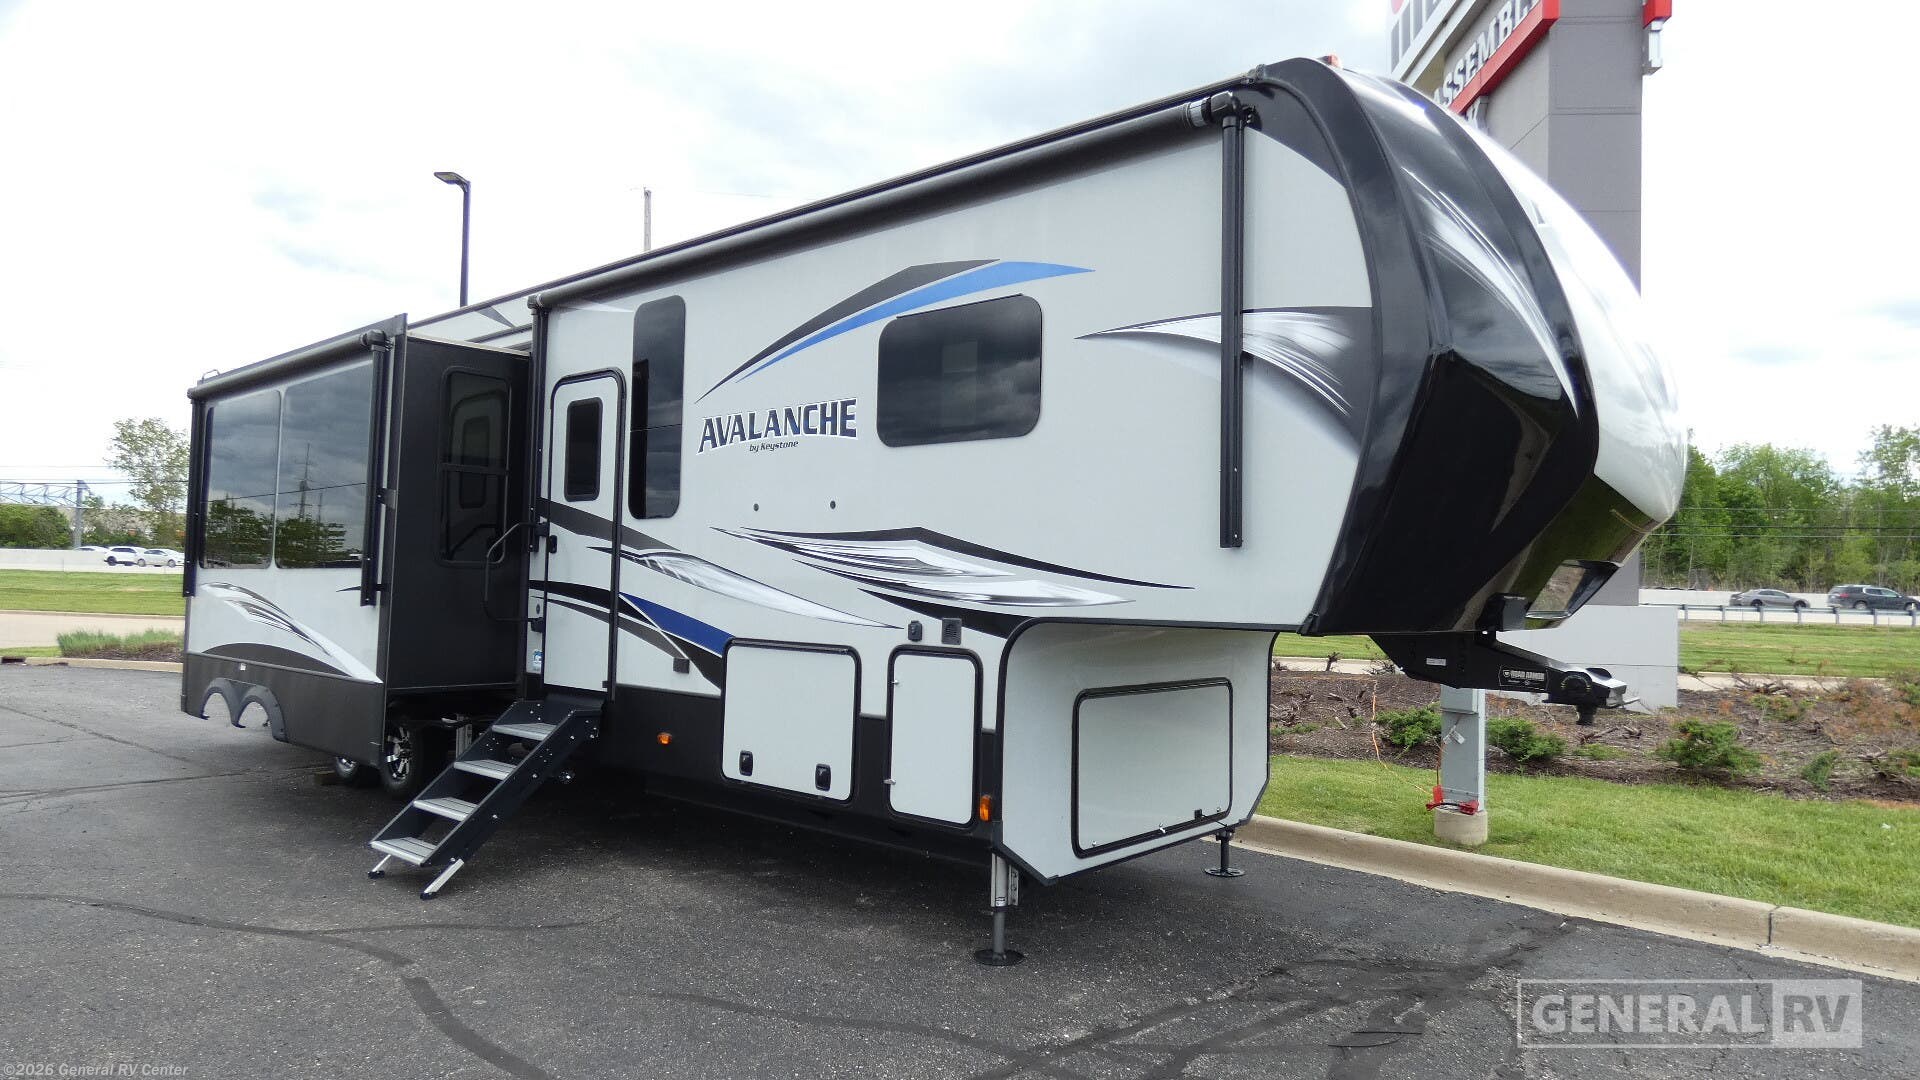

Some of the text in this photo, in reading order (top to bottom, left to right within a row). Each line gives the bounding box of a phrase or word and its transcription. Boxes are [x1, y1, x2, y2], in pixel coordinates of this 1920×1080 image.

[1433, 0, 1538, 107] ASSEMBL
[697, 398, 858, 455] AVALANCHE
[749, 441, 799, 452] by Keystone
